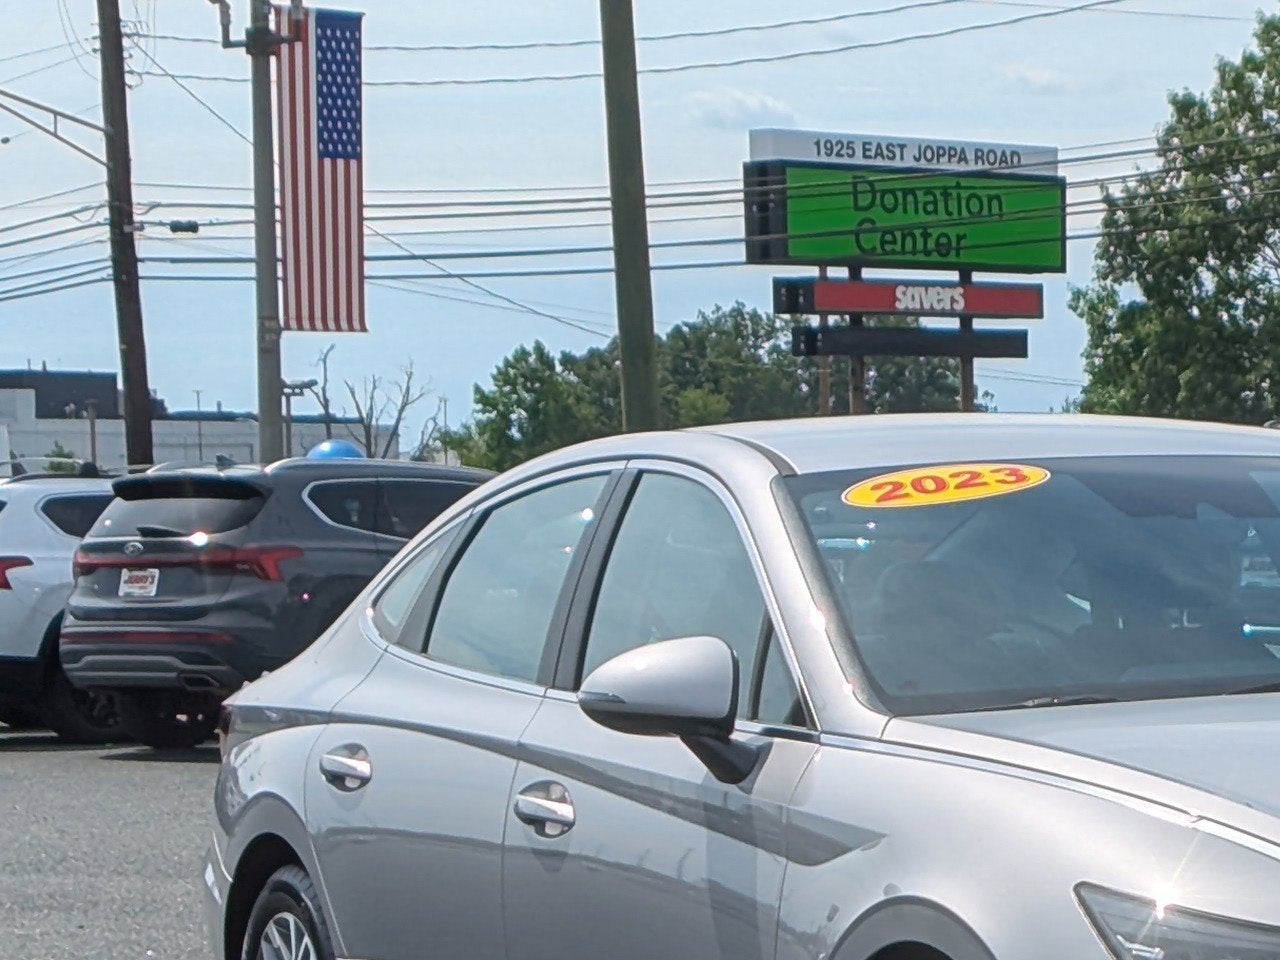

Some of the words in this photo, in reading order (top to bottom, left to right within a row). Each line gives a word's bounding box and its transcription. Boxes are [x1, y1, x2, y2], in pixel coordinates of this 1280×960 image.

[813, 138, 856, 160] 1925
[861, 141, 908, 162] EAST
[912, 144, 969, 165] JOPPA
[974, 147, 1022, 167] ROAD
[852, 175, 1004, 218] Donation
[854, 216, 968, 258] Center
[895, 284, 966, 311] savers
[869, 466, 1031, 504] 2023
